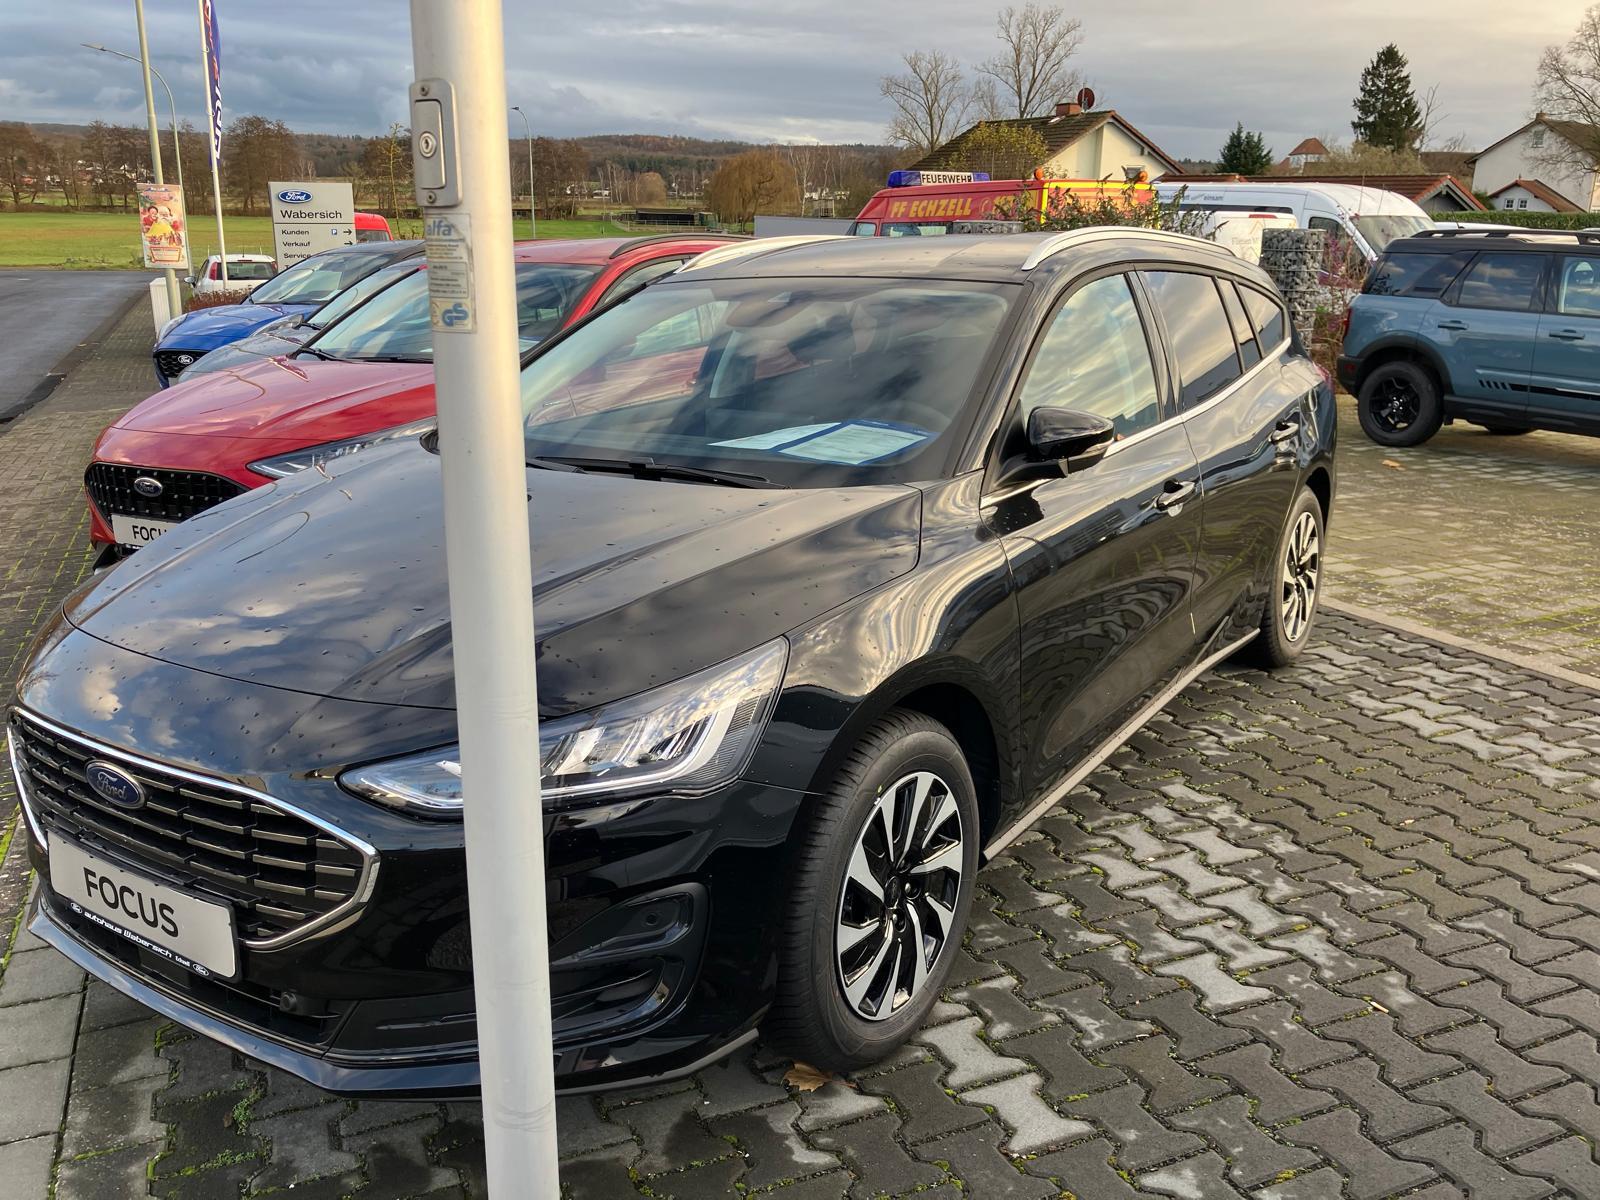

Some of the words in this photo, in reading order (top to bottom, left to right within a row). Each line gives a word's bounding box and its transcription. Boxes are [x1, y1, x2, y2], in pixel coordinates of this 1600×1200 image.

[921, 174, 972, 183] FEUERWEHR
[280, 210, 342, 219] Wabersich
[890, 201, 908, 218] FF
[908, 197, 972, 218] ECHZELL
[96, 771, 127, 800] Ford
[83, 866, 179, 938] FOCUS
[84, 911, 122, 934] autohaus
[123, 929, 172, 959] Wabersich
